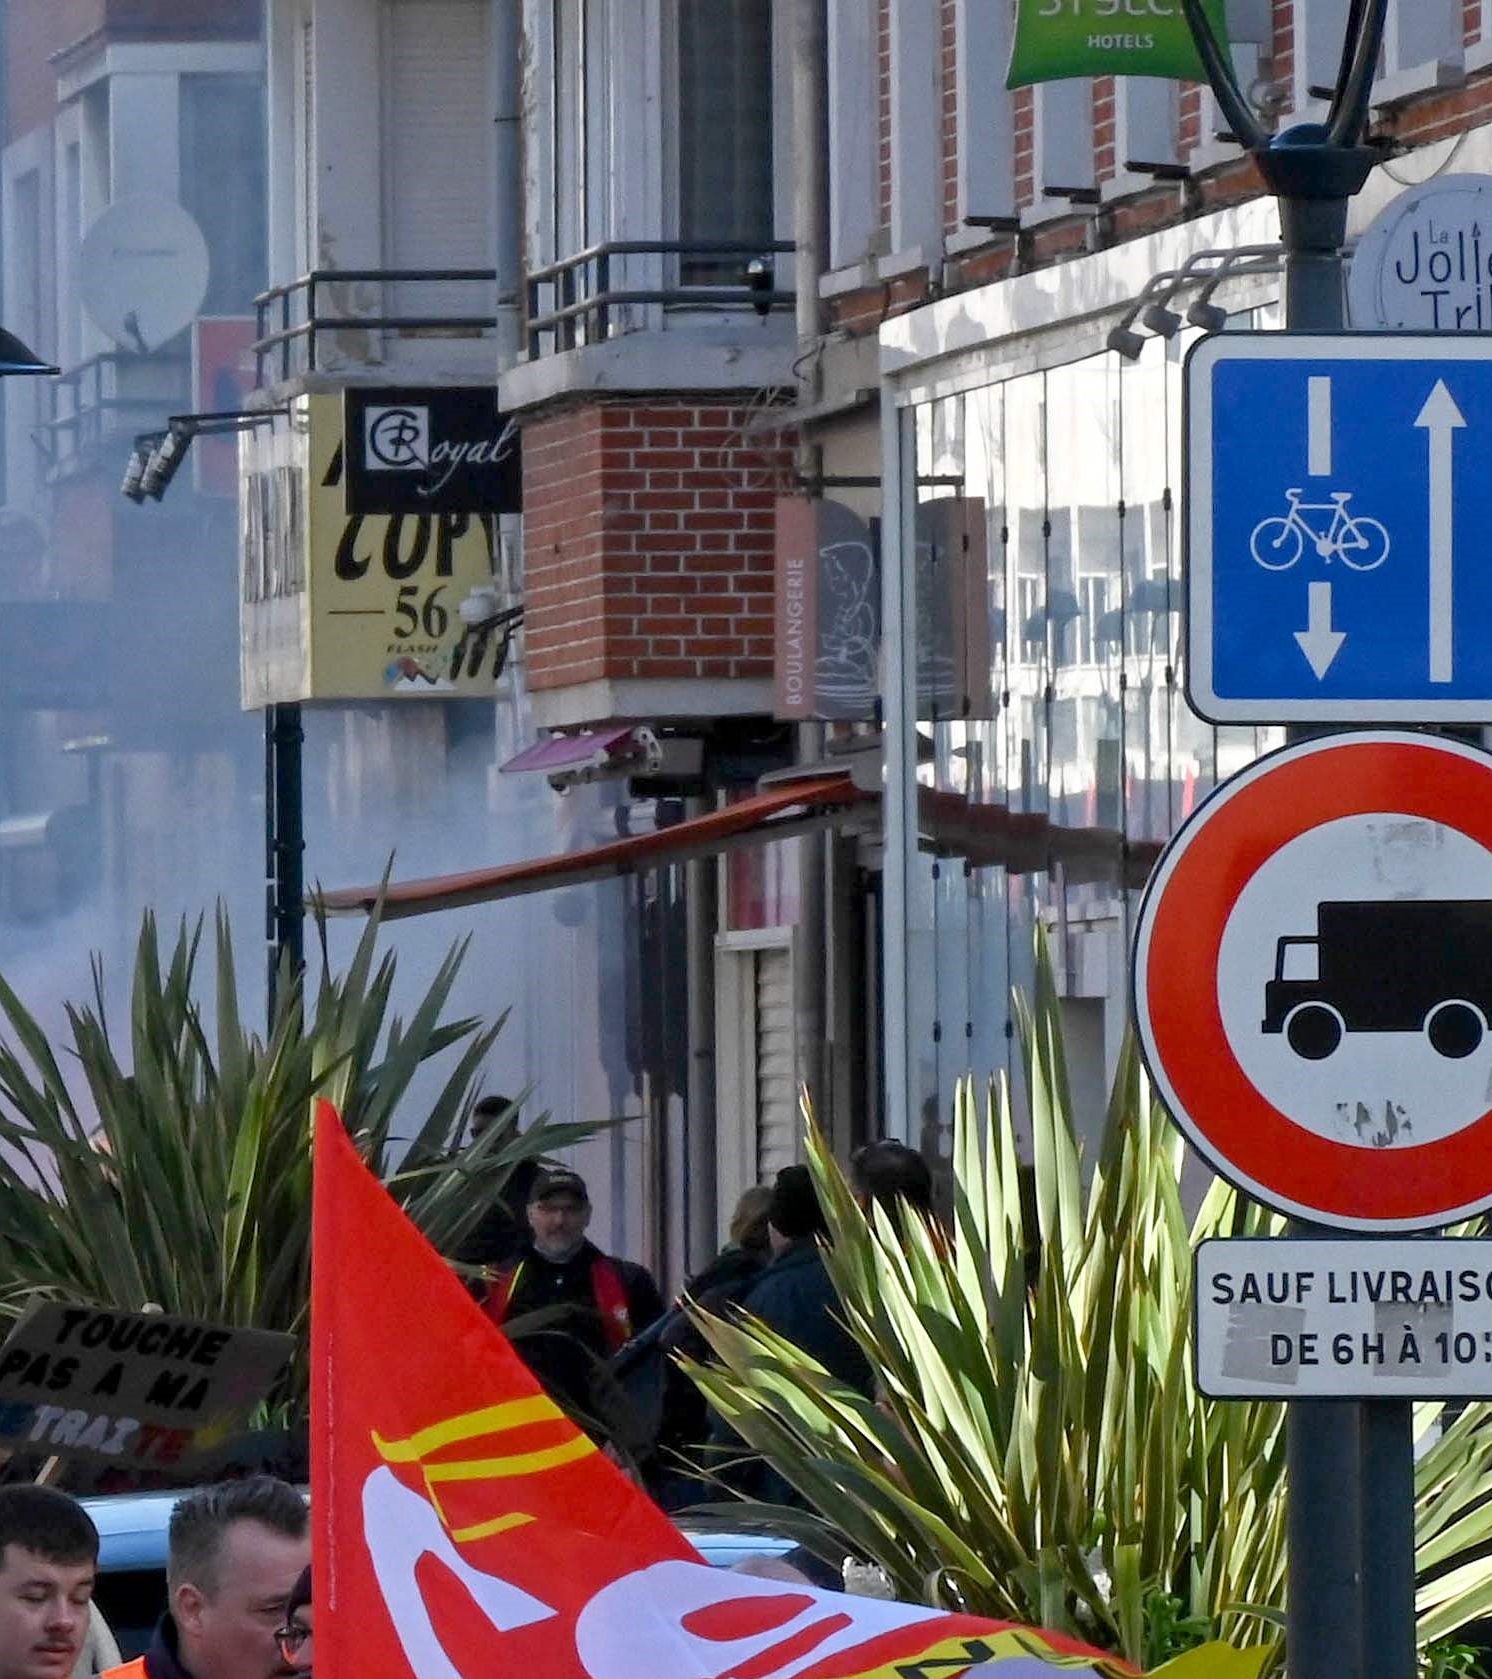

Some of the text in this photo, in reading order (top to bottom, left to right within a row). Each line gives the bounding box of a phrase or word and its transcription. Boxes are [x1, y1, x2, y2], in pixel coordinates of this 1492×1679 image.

[1087, 34, 1154, 49] HOTELS
[1396, 222, 1492, 285] Joli
[1428, 219, 1449, 244] La
[1420, 284, 1492, 329] Tri
[393, 585, 449, 639] 56
[785, 559, 805, 706] BOULANGERIE
[1212, 1270, 1492, 1305] SAUF LIVRAIS
[56, 1310, 233, 1366] TOUCHE
[1271, 1324, 1492, 1366] DE 6H À 10
[92, 1362, 124, 1396] A
[145, 1370, 210, 1410] MA
